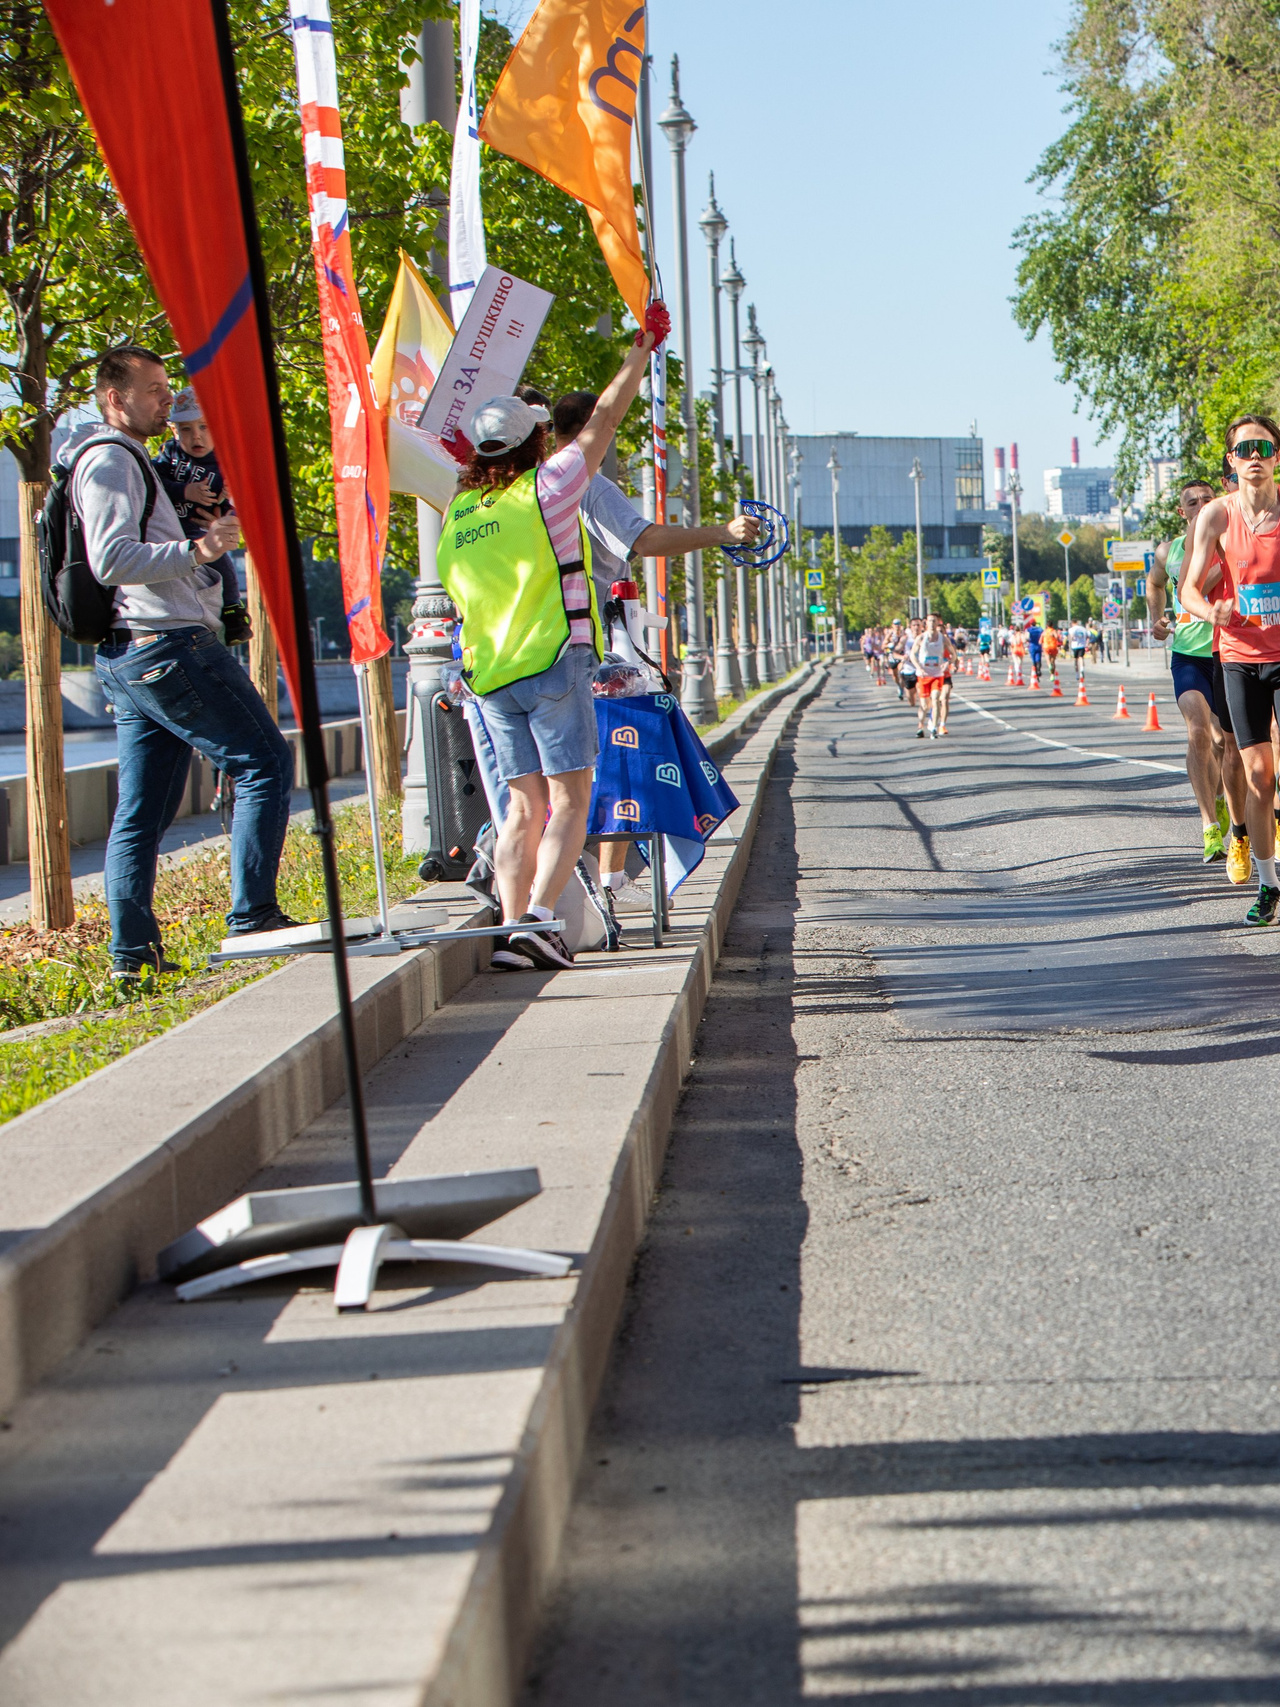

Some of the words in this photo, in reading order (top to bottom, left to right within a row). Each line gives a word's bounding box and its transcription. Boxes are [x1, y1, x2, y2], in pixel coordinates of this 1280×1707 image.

[469, 276, 513, 361] ПУШКИНО
[453, 367, 480, 395] ЗА
[441, 397, 466, 439] БЕГИ
[1261, 613, 1280, 626] 5KM
